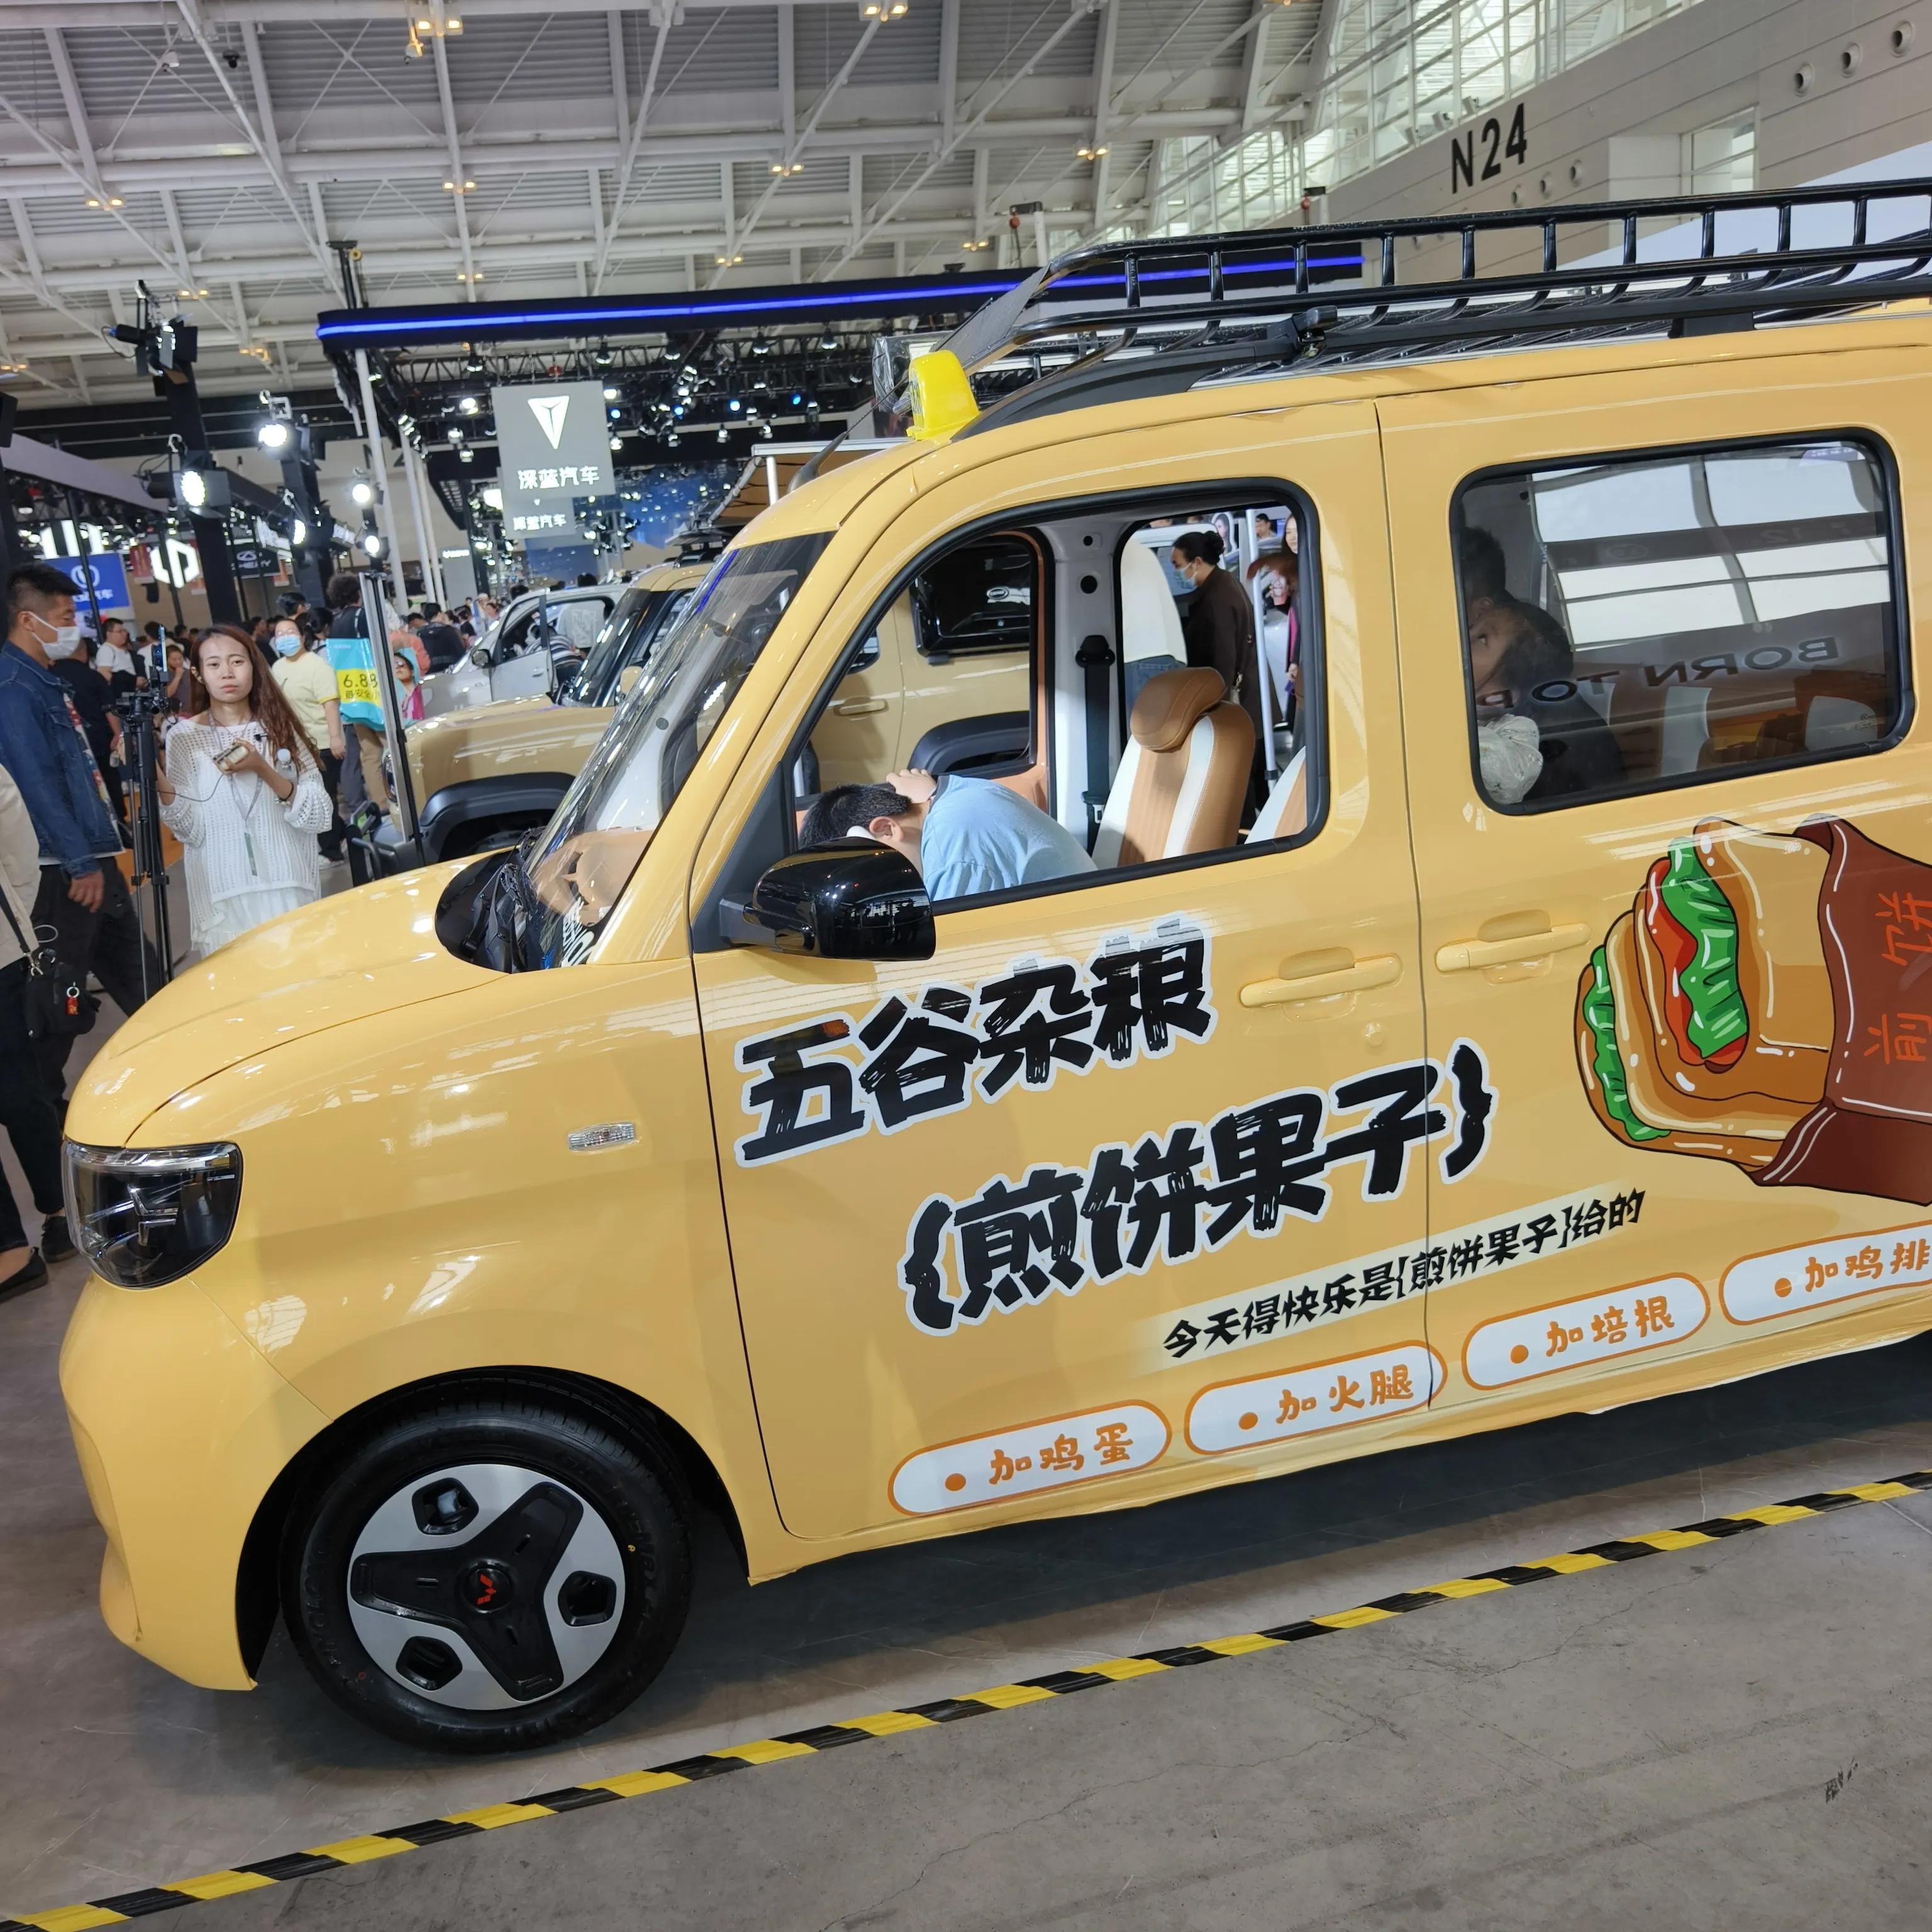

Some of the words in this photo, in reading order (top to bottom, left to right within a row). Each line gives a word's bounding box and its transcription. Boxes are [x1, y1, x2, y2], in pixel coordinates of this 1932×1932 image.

[1452, 103, 1527, 194] N24
[517, 465, 600, 490] 深蓝汽车
[343, 673, 377, 688] 6.88
[742, 918, 1211, 1161] 五谷杂粮
[1805, 1238, 1931, 1293] 加鸡排
[1545, 1295, 1674, 1357] 加培根
[1275, 1363, 1414, 1425] 加火腿
[989, 1422, 1134, 1485] 加鸡蛋
